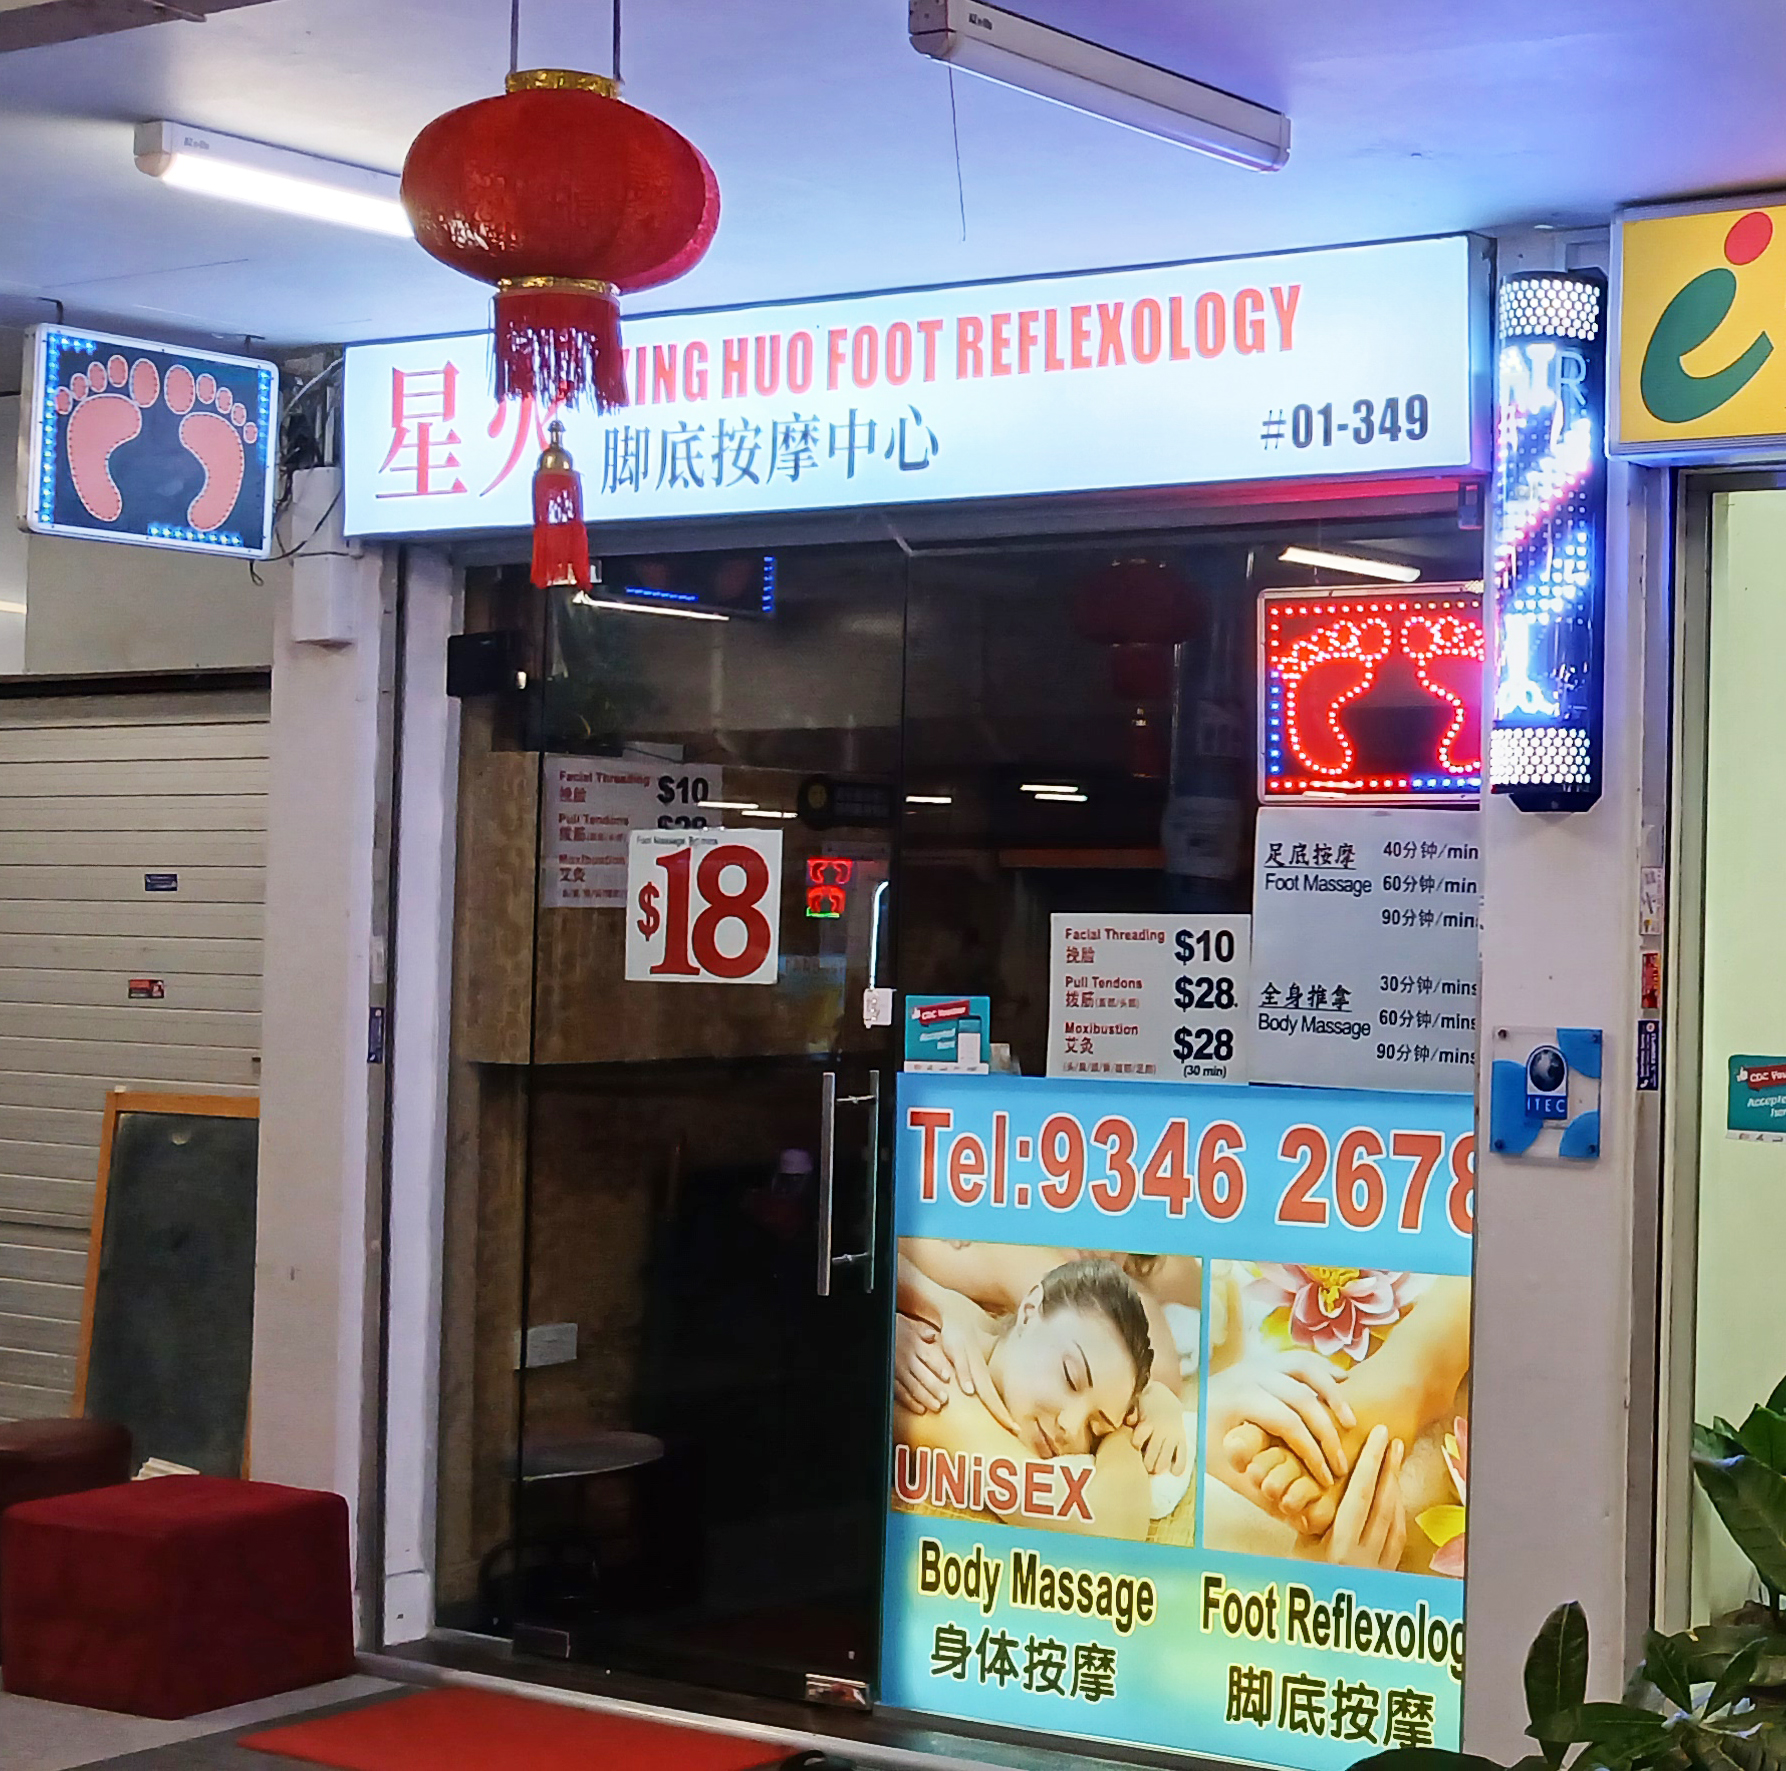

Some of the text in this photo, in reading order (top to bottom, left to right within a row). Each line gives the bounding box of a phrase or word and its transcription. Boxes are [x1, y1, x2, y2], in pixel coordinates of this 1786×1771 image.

[722, 331, 813, 399] HUO
[826, 318, 944, 392] FOOT
[955, 284, 1303, 382] REFLEXOLOGY
[602, 404, 940, 495] 脚底按摩中心
[1260, 394, 1429, 451] #01-349
[1264, 843, 1356, 867] 足底按摩
[637, 844, 771, 978] $18
[1265, 873, 1372, 897] Foot Massage
[1065, 928, 1234, 966] Facial Threading $10
[1065, 976, 1088, 988] Pull
[1092, 976, 1142, 989] Tendons
[1259, 982, 1352, 1008] 全身推拿
[1065, 1022, 1233, 1064] Moxibustion $28
[1258, 1016, 1371, 1040] Body Massage
[1184, 1065, 1227, 1078] (30 min)
[1527, 1097, 1566, 1113] ITEC
[907, 1108, 1246, 1224] Tel:9346
[895, 1445, 1096, 1522] UNiSEX
[919, 1537, 1157, 1635] Body Massage
[1200, 1574, 1278, 1641] Foot
[930, 1623, 1118, 1703] 身体按摩
[1226, 1665, 1436, 1749] 脚底按摩
